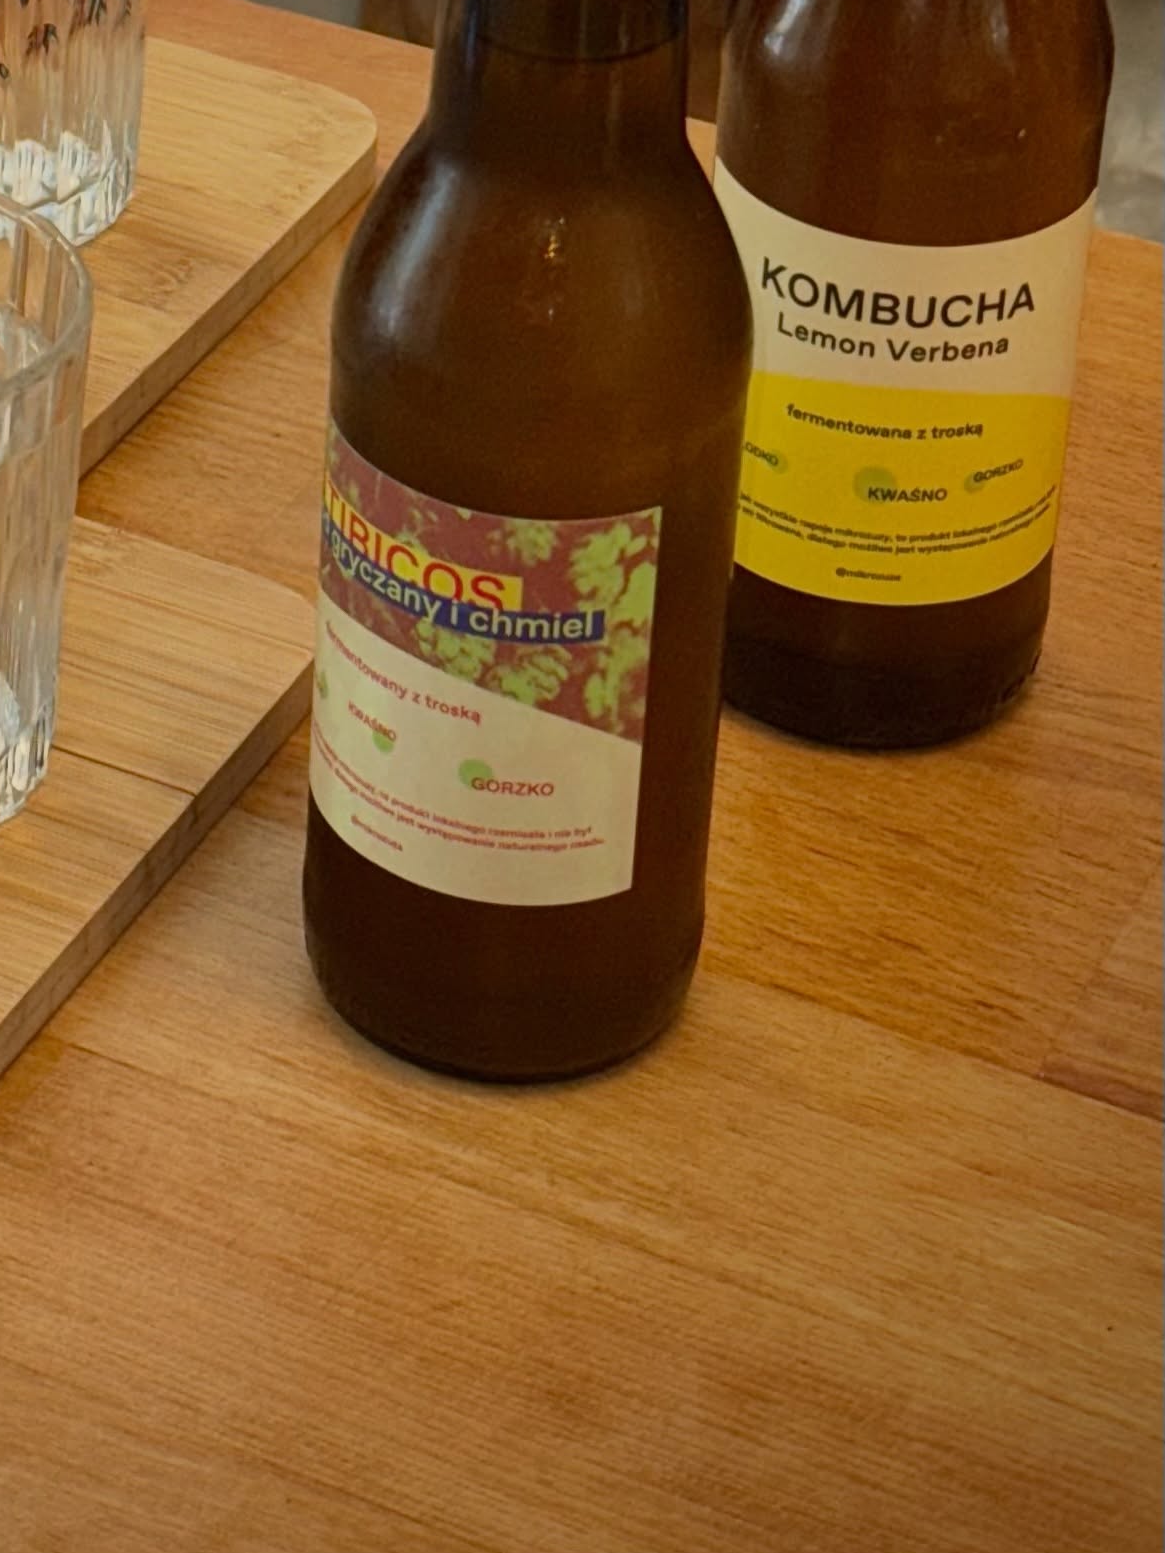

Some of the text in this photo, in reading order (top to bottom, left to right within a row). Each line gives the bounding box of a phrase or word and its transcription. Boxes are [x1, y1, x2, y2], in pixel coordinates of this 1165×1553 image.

[761, 256, 1036, 328] KOMBUCHA
[777, 312, 1010, 362] Lemon Verbena
[785, 403, 983, 440] fermentowana z troską
[972, 458, 1024, 484] GORZKO
[867, 485, 948, 504] KWAŚNO
[449, 599, 459, 625] i
[468, 610, 594, 640] chmiel
[412, 692, 421, 705] z
[424, 695, 482, 727] troską
[470, 776, 555, 797] GORZKO
